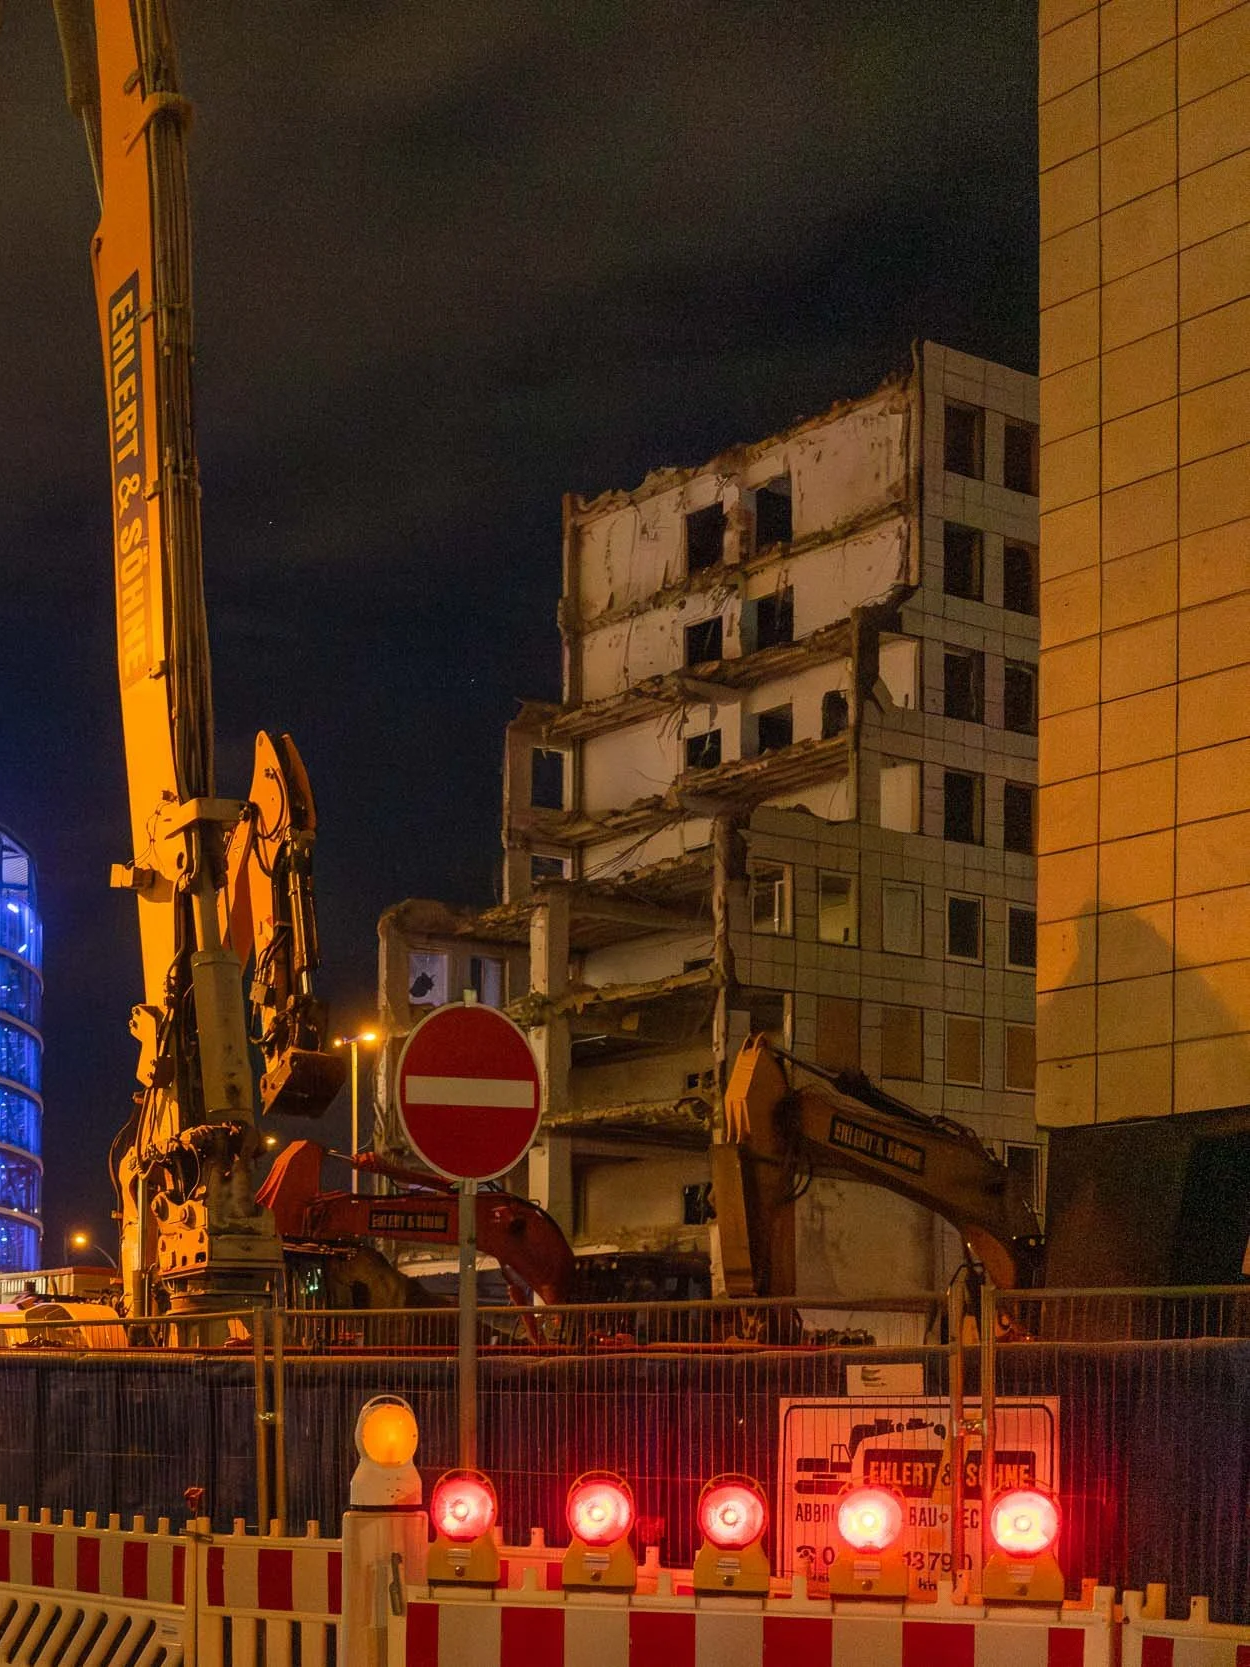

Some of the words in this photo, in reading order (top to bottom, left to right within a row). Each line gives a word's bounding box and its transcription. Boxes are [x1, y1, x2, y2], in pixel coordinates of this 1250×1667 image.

[111, 290, 139, 464] EHLERT
[118, 473, 140, 518] &
[120, 517, 148, 678] SÖHNE
[869, 1462, 937, 1488] EHLERT
[965, 1464, 1031, 1490] SHNE
